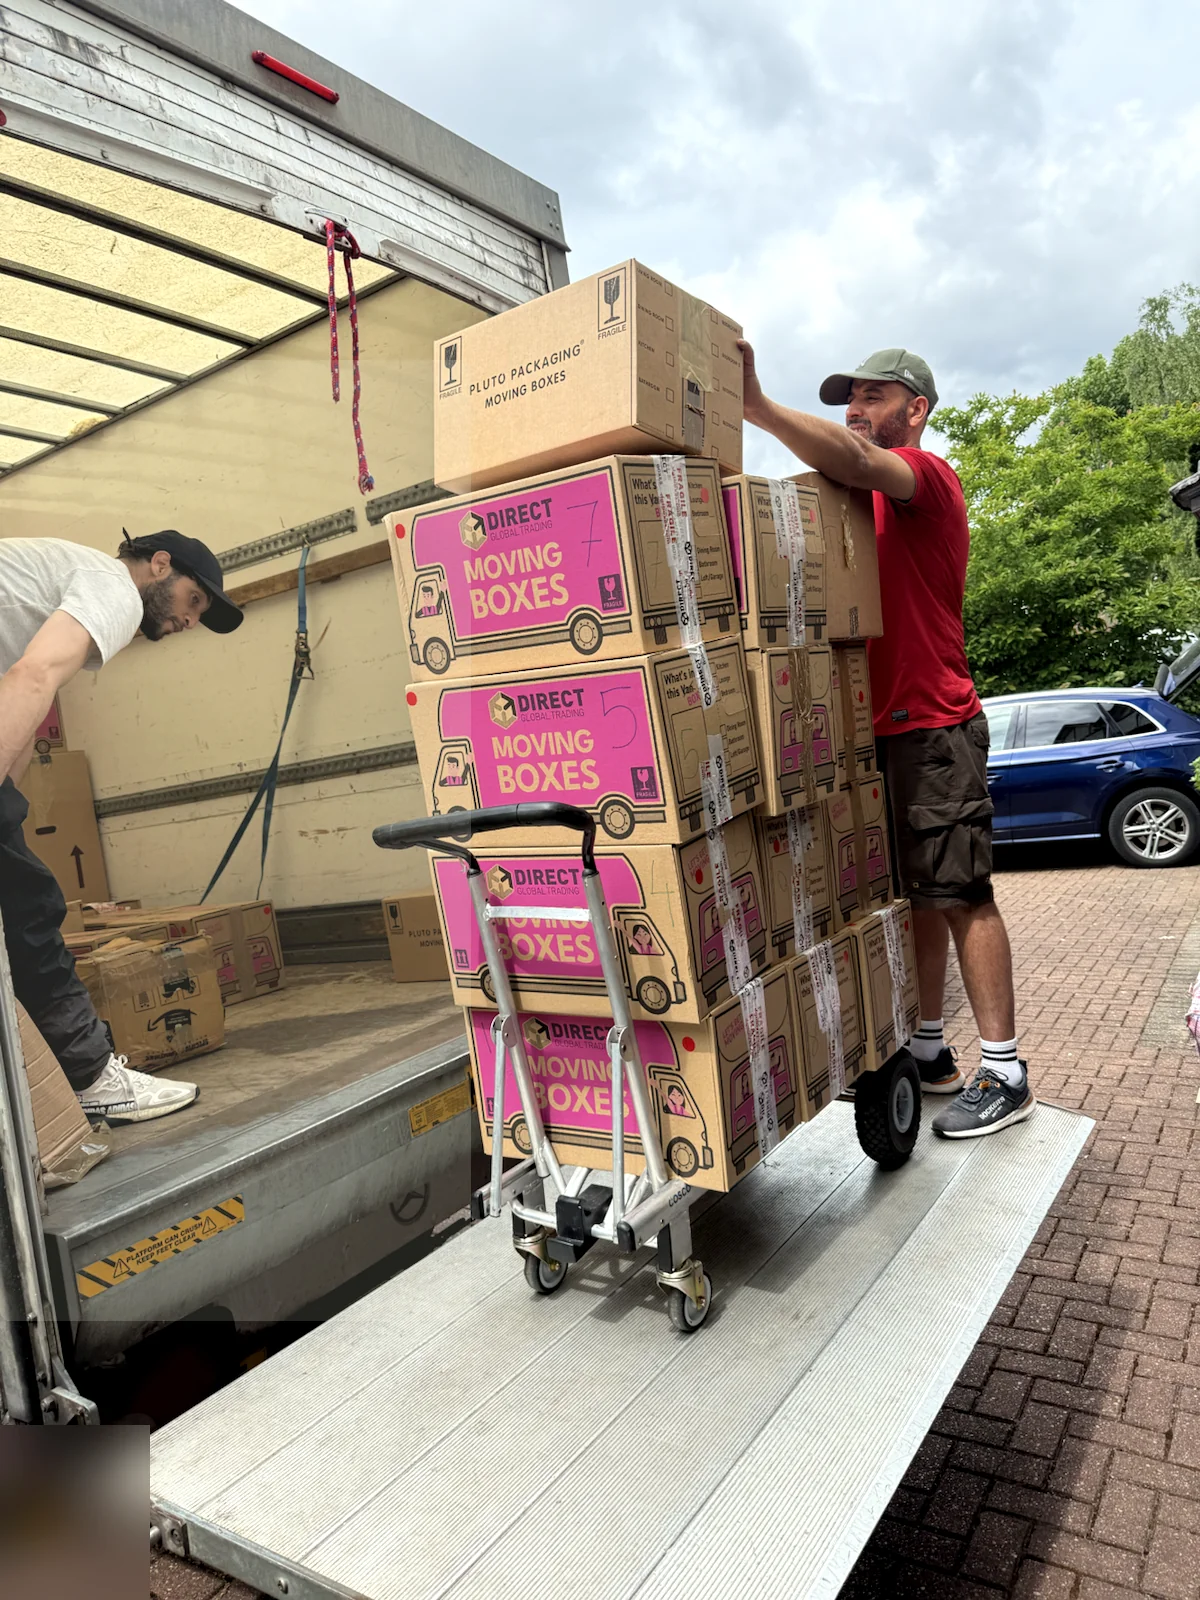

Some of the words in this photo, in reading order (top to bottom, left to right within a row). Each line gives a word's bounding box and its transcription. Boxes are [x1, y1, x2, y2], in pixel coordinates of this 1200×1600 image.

[597, 324, 627, 341] FRAGILE
[439, 386, 462, 400] FRAGILE
[469, 373, 506, 396] PLUTO
[484, 384, 527, 409] MOVING
[531, 370, 566, 392] BOXES
[634, 494, 648, 504] this
[486, 498, 552, 531] DIRECT
[490, 528, 520, 541] GLOBAL
[520, 520, 553, 535] TRADING
[463, 541, 563, 584] MOVING
[469, 572, 569, 619] BOXES
[663, 670, 688, 685] What's
[517, 689, 584, 712] DIRECT
[666, 687, 681, 699] this
[520, 713, 550, 723] GLOBAL
[551, 708, 585, 720] TRADING
[600, 686, 637, 749] 5
[491, 729, 594, 759] MOVING
[496, 759, 600, 794] BOXES
[514, 869, 580, 886] DIRECT
[517, 886, 547, 896] GLOBAL
[547, 887, 580, 896] TRADING
[651, 860, 675, 927] 4
[408, 929, 430, 938] PLUTO
[551, 1023, 610, 1041] DIREC
[555, 1039, 583, 1049] GLOBAL
[107, 1100, 135, 1114] ADIDAS
[668, 1184, 692, 1207] COSCO
[126, 1238, 163, 1263] PLATFORM
[164, 1233, 179, 1244] CAN
[180, 1220, 203, 1237] CRUSH
[136, 1251, 155, 1265] KEEP
[156, 1243, 173, 1256] FEET
[174, 1232, 196, 1247] CLEAR
